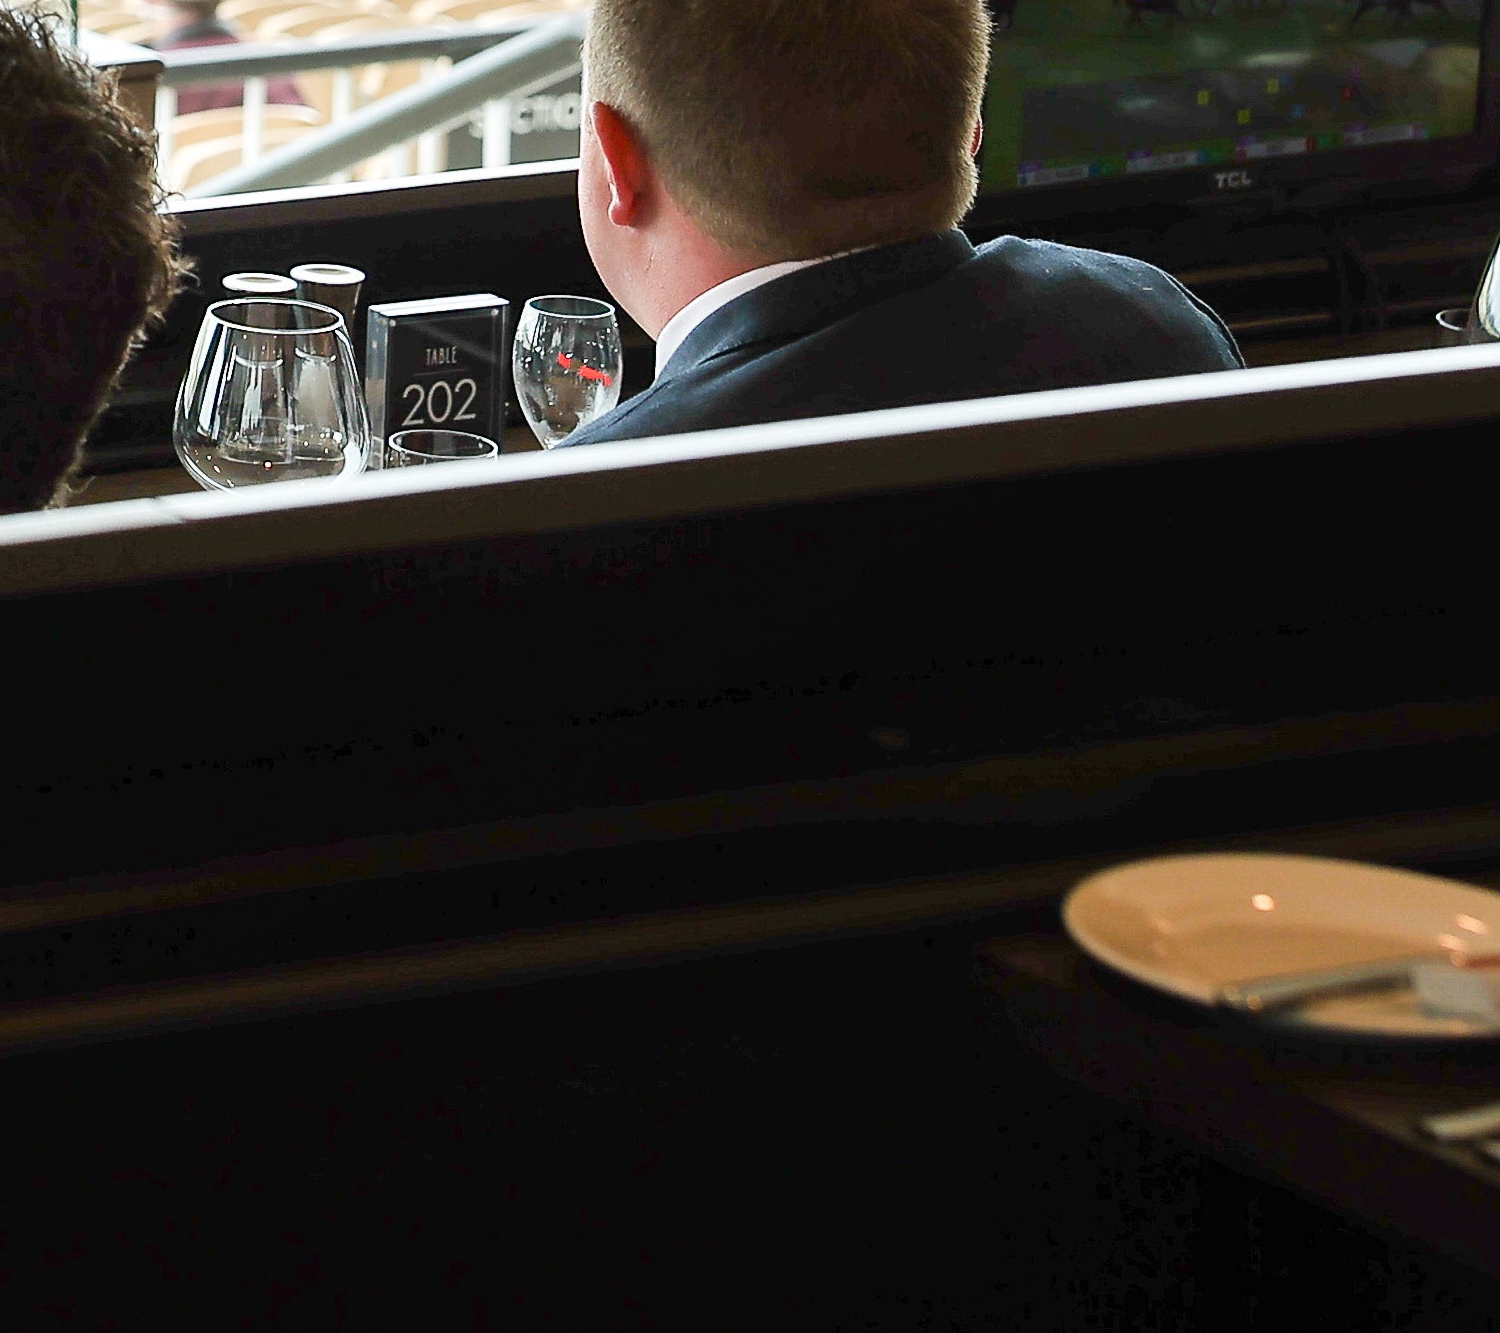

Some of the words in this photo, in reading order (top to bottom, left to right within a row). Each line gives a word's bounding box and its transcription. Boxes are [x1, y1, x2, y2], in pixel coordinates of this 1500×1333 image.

[1214, 171, 1251, 189] TCL
[425, 345, 458, 366] TABLE
[402, 378, 478, 428] 202
